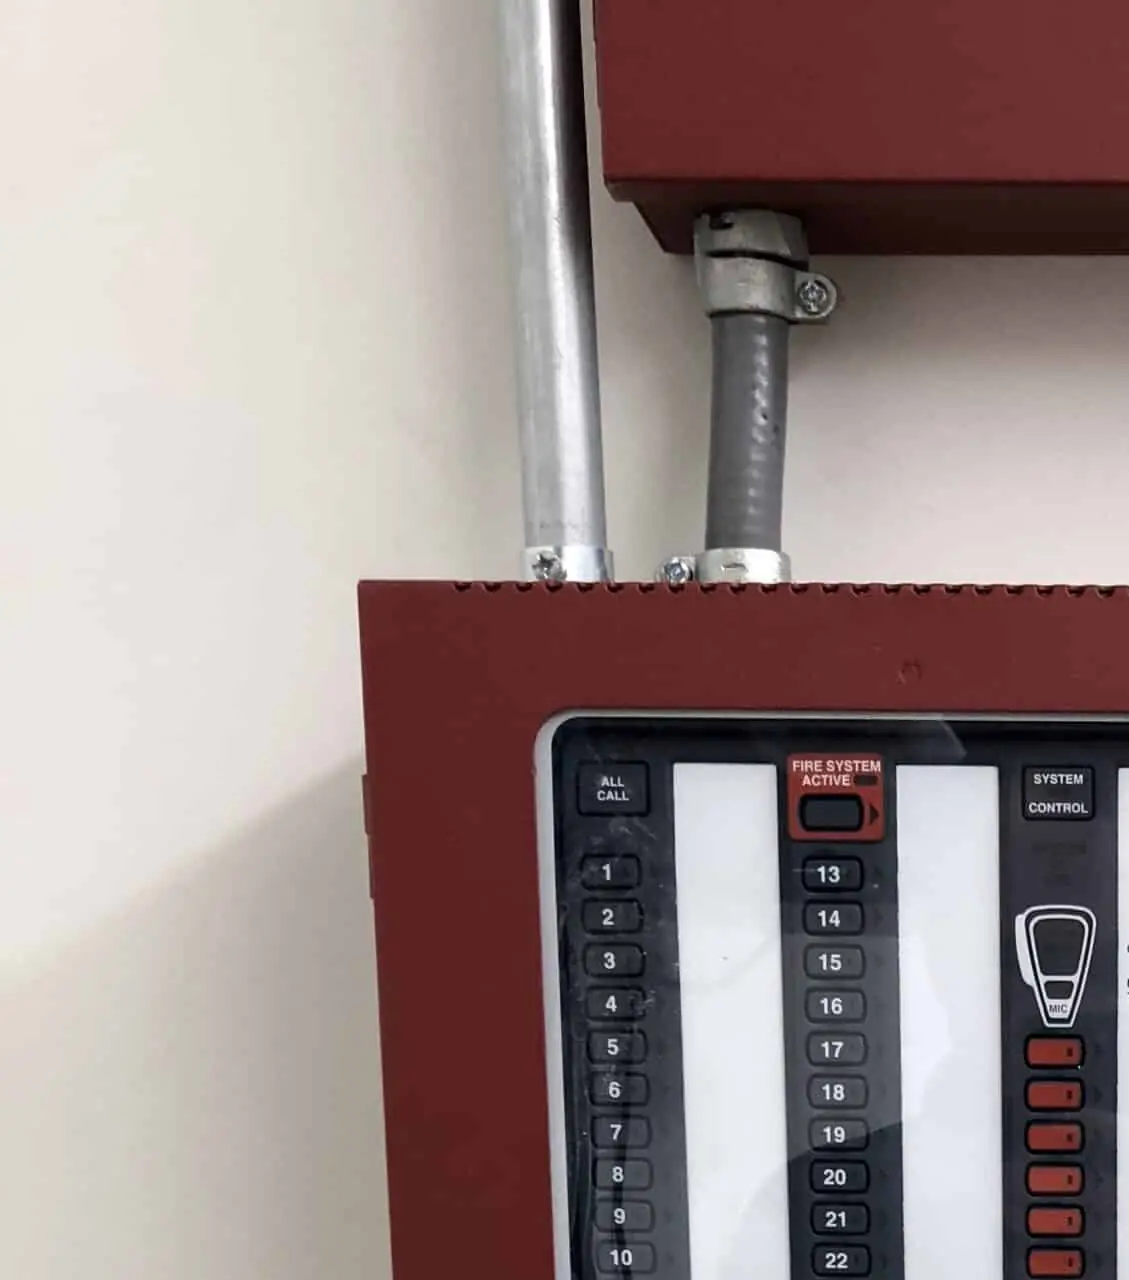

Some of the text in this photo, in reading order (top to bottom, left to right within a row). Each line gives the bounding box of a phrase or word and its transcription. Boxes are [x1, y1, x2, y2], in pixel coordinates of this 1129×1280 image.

[792, 760, 881, 772] FIRE SYSTEM
[601, 776, 625, 788] ALL
[801, 774, 851, 787] ACTIVE
[1033, 774, 1084, 785] SYSTEM
[597, 790, 629, 800] CALL
[1028, 802, 1089, 814] CONTROL
[603, 864, 610, 880] 1
[817, 866, 840, 882] 13
[603, 909, 614, 925] 2
[818, 910, 840, 927] 14
[604, 952, 615, 969] 3
[819, 954, 841, 970] 15
[606, 996, 617, 1012] 4
[821, 998, 842, 1014] 16
[1048, 1004, 1068, 1013] MIC
[608, 1039, 619, 1055] 5
[822, 1042, 843, 1057] 17
[609, 1082, 620, 1098] 6
[823, 1084, 844, 1100] 18
[610, 1124, 622, 1140] 7
[824, 1126, 845, 1142] 19
[612, 1166, 624, 1182] 8
[824, 1169, 846, 1185] 20
[614, 1208, 625, 1224] 9
[826, 1211, 845, 1227] 21
[610, 1249, 632, 1265] 10
[826, 1253, 848, 1268] 22
